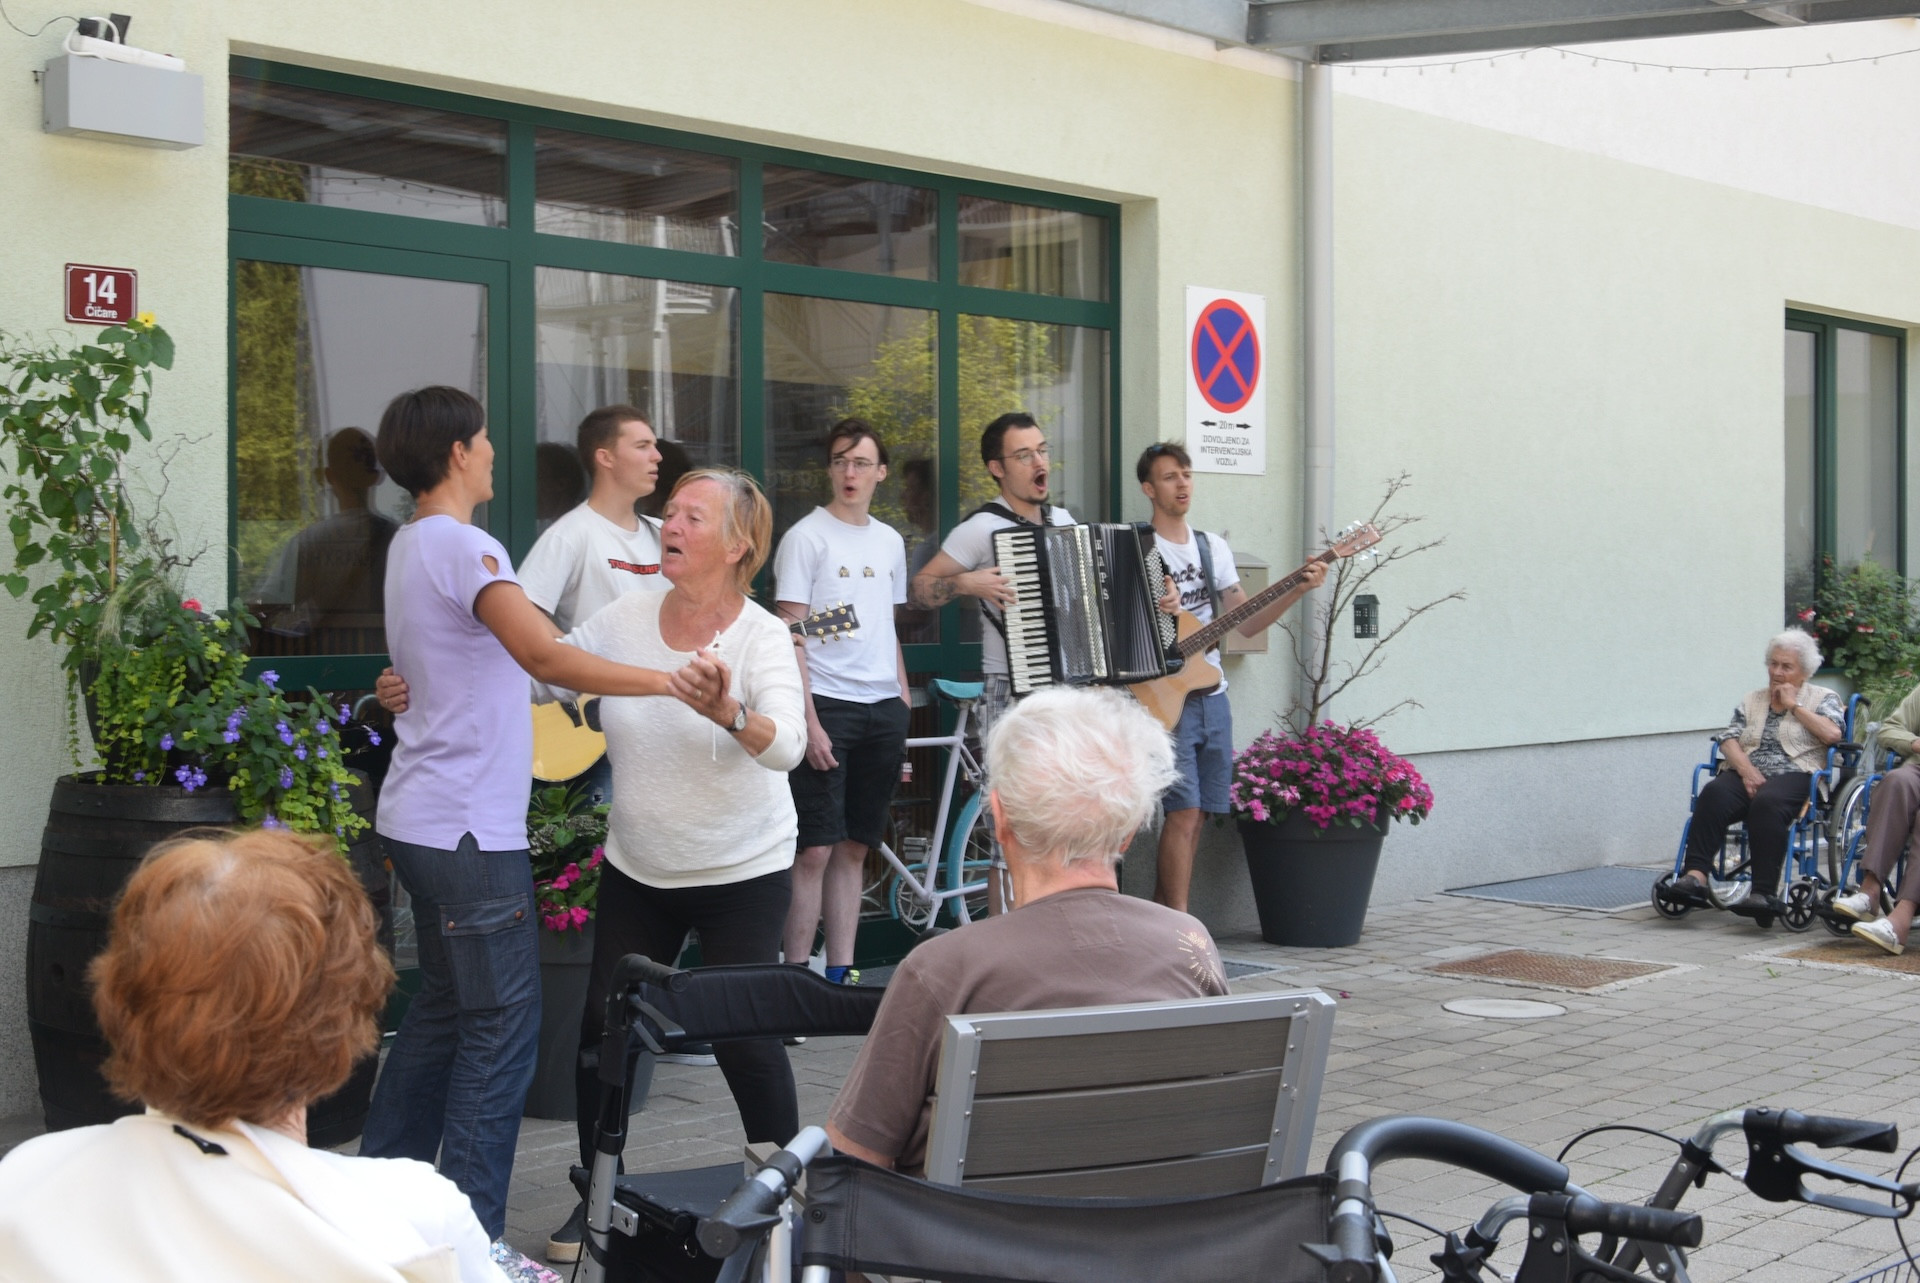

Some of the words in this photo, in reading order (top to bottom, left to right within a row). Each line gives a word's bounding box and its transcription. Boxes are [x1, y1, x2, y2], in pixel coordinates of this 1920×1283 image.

[83, 272, 117, 305] 14
[1203, 435, 1241, 445] DOVOLJENO
[1241, 437, 1251, 446] ZA
[1215, 457, 1238, 466] VOZILA
[1095, 539, 1110, 600] KAPS
